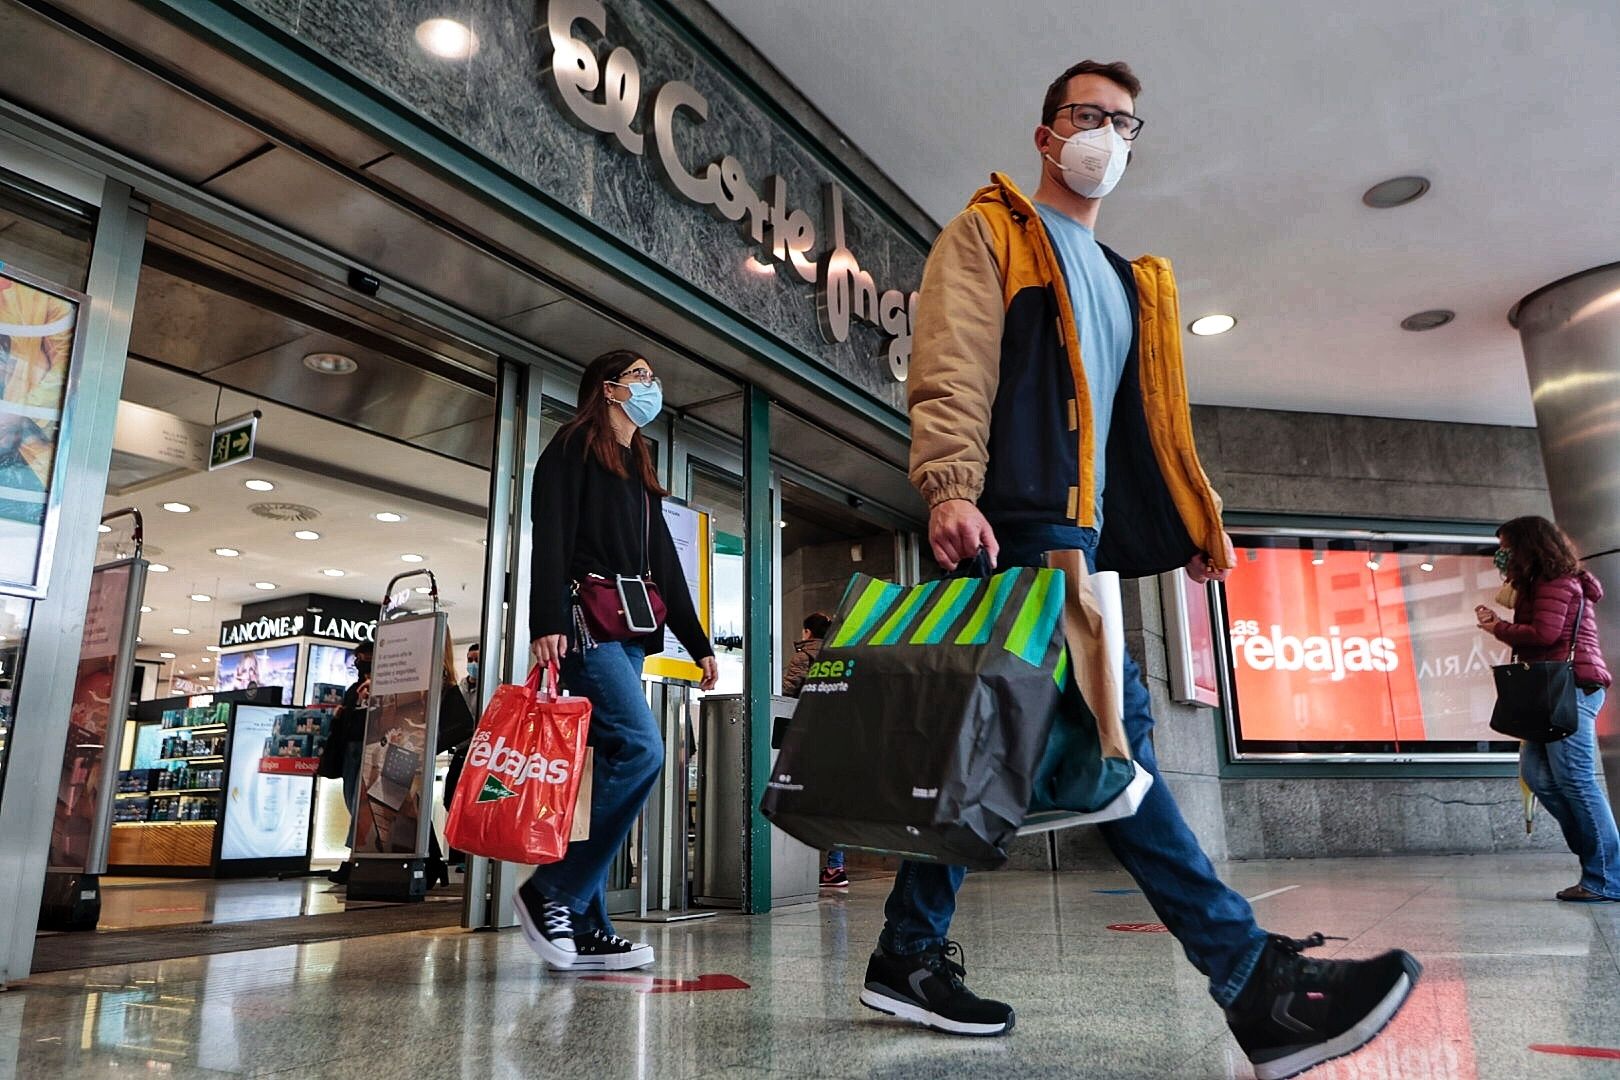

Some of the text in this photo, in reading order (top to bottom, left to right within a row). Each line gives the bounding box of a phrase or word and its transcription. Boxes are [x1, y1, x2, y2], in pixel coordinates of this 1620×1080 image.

[548, 0, 920, 382] El Corte Ing
[222, 616, 290, 646] LANCÔME
[1230, 619, 1260, 636] as
[1231, 624, 1399, 682] rebajas
